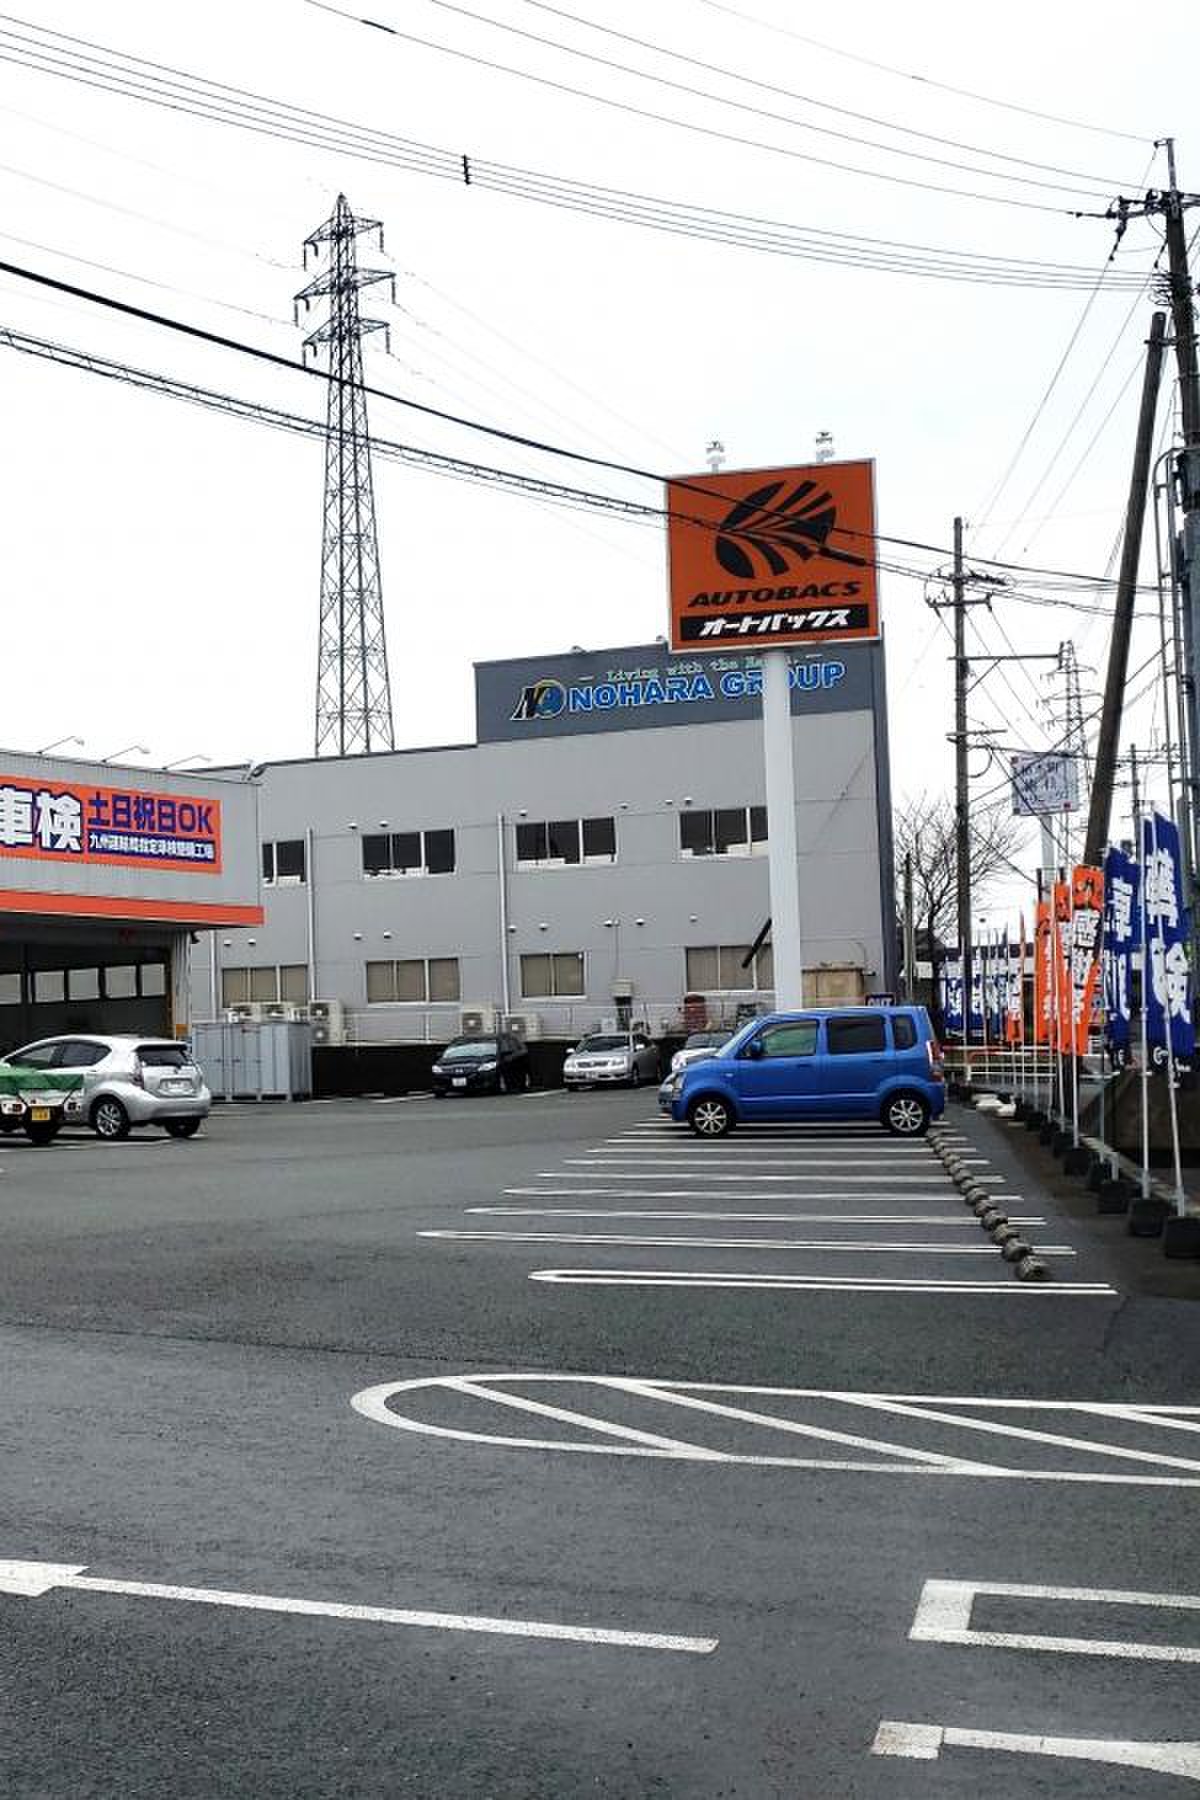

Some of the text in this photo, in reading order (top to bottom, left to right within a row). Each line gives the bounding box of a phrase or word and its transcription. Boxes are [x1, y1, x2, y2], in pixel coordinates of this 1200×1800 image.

[688, 580, 862, 608] AUTOBACS
[700, 608, 851, 638] オートバックス
[568, 671, 715, 712] NOHARA
[720, 660, 846, 698] GRUP
[87, 790, 214, 834] 土日祝日OK
